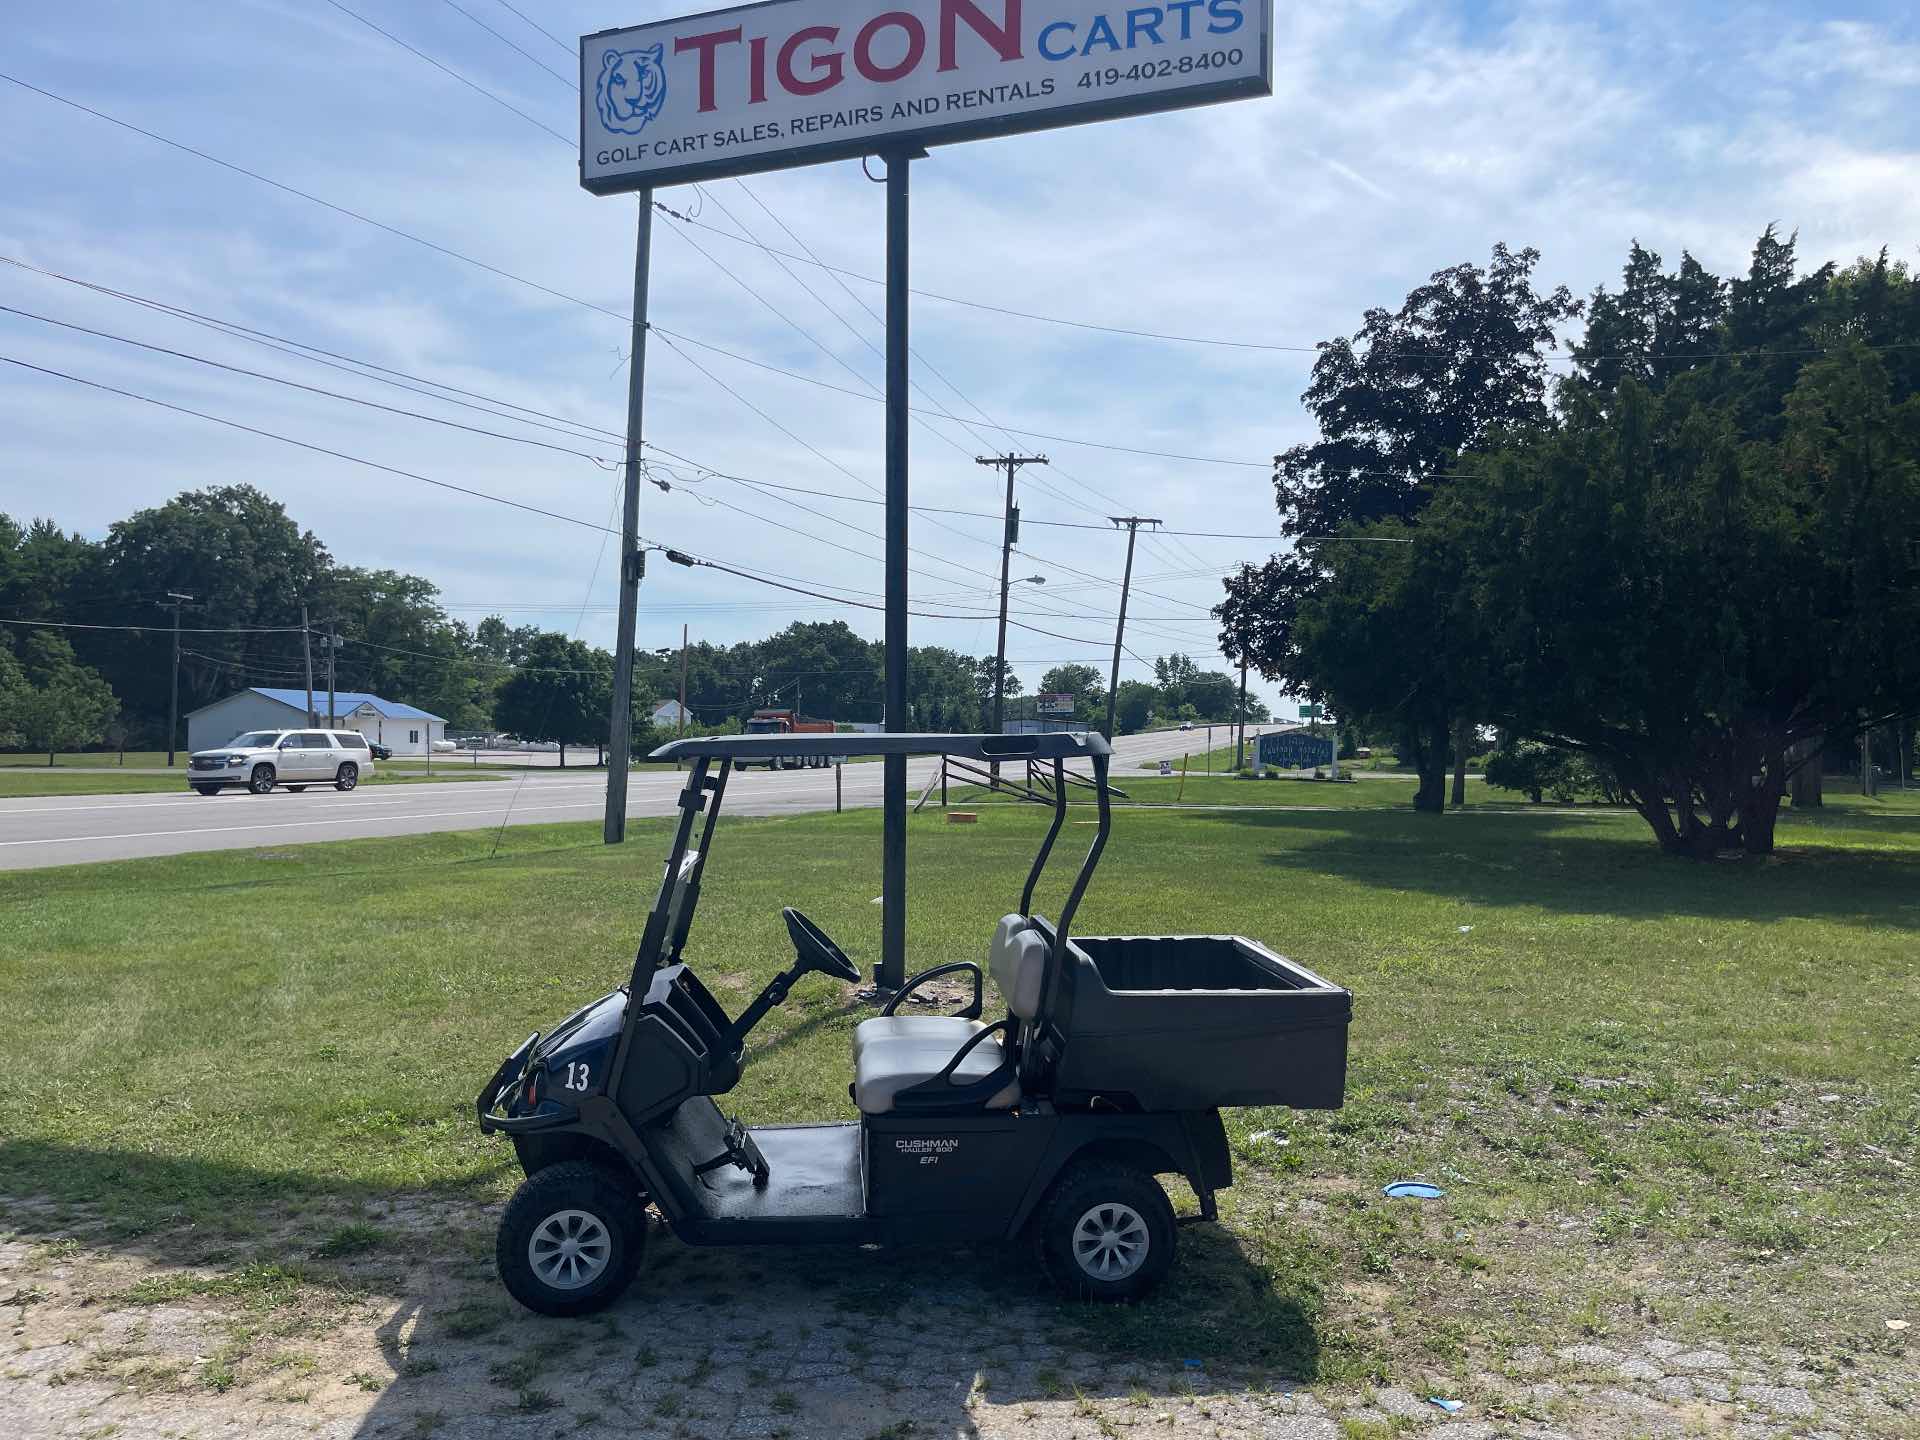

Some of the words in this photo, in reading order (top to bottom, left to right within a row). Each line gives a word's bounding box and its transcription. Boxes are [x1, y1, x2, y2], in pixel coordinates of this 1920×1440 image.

[674, 0, 1025, 113] TIGON
[1037, 0, 1245, 62] CARTS
[596, 144, 649, 166] GOLF
[653, 134, 709, 156] CART
[713, 122, 785, 148] SALES,
[790, 105, 884, 136] REPAIRS
[891, 97, 940, 120] AND
[946, 78, 1055, 111] RENTALS
[1077, 48, 1244, 89] 419-402-8400
[565, 1061, 590, 1092] 13
[895, 1139, 959, 1148] CUSHMAN
[920, 1156, 939, 1164] EFI
